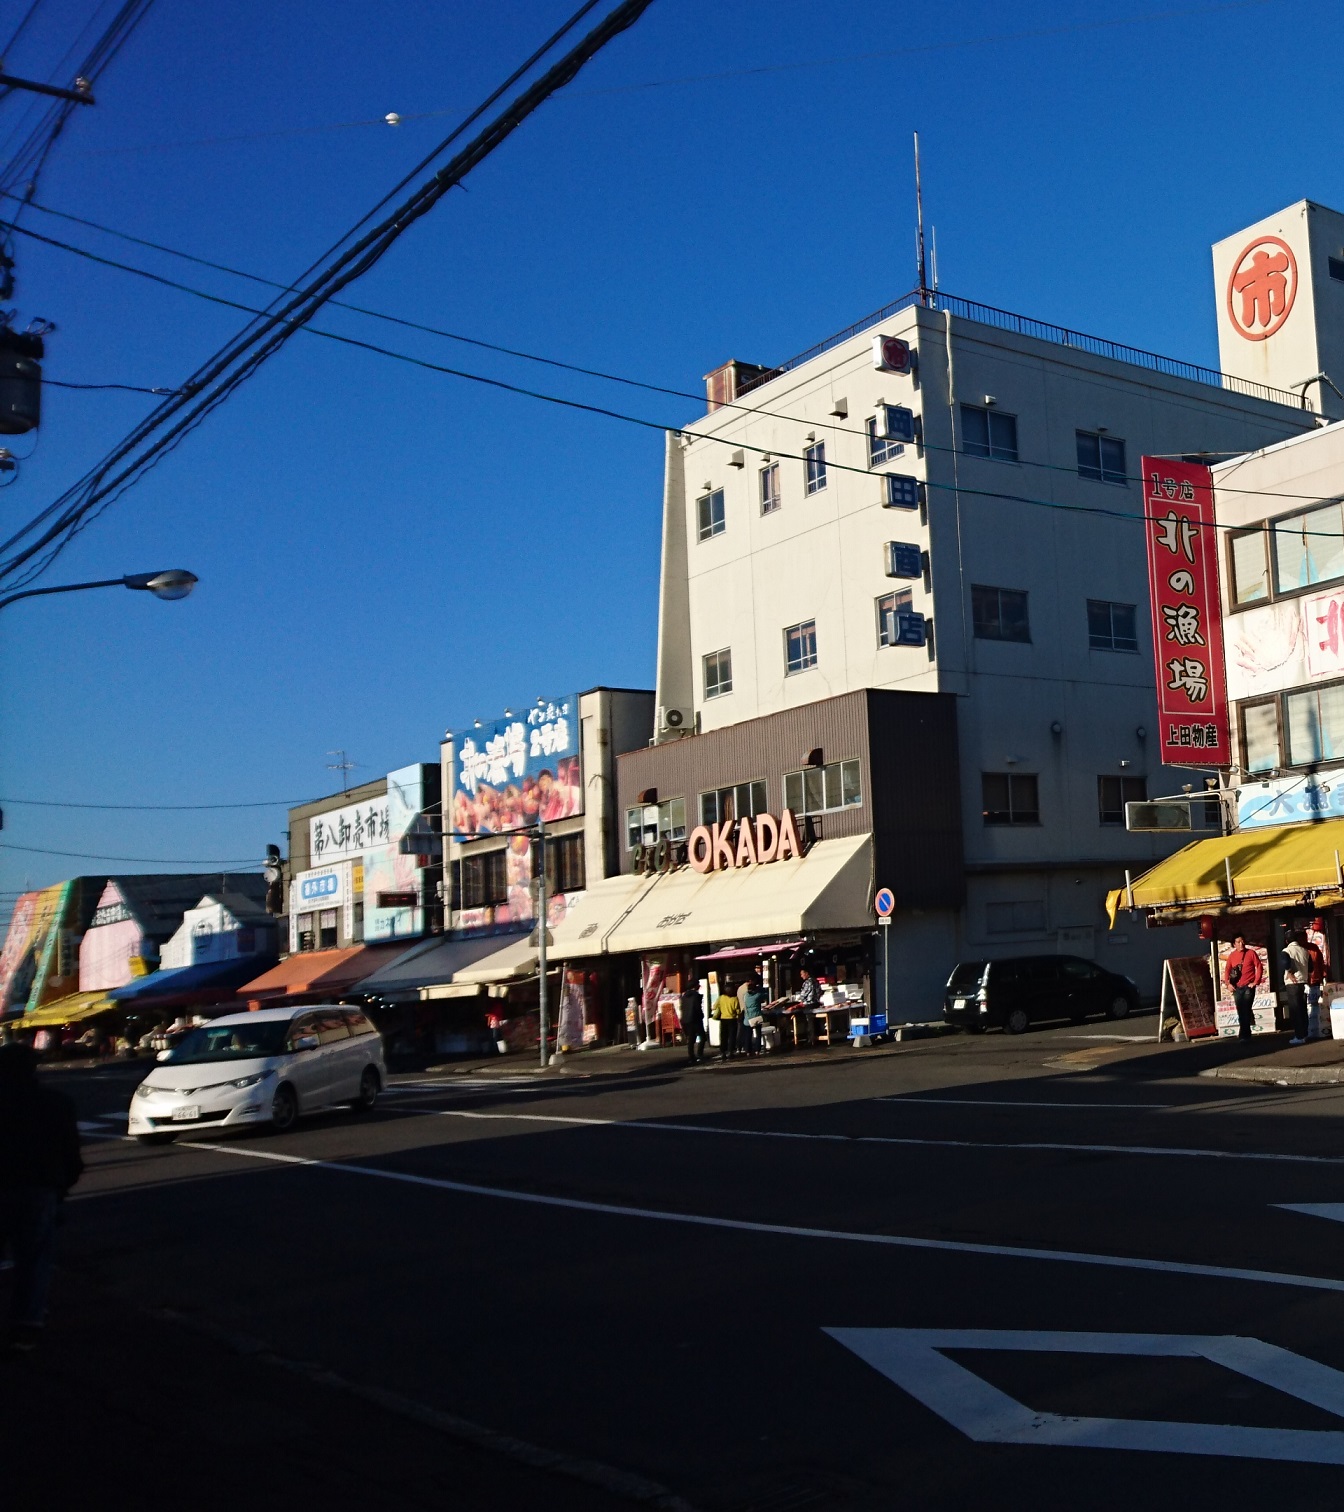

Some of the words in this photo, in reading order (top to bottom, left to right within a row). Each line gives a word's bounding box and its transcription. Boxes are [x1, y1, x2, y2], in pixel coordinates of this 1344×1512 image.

[1233, 251, 1289, 328] 市
[1151, 472, 1195, 501] 1号店
[1156, 510, 1209, 702] 北の漁場
[1166, 723, 1219, 748] 上田物産
[313, 804, 391, 860] 第八卸売市場
[688, 808, 800, 874] OKADA
